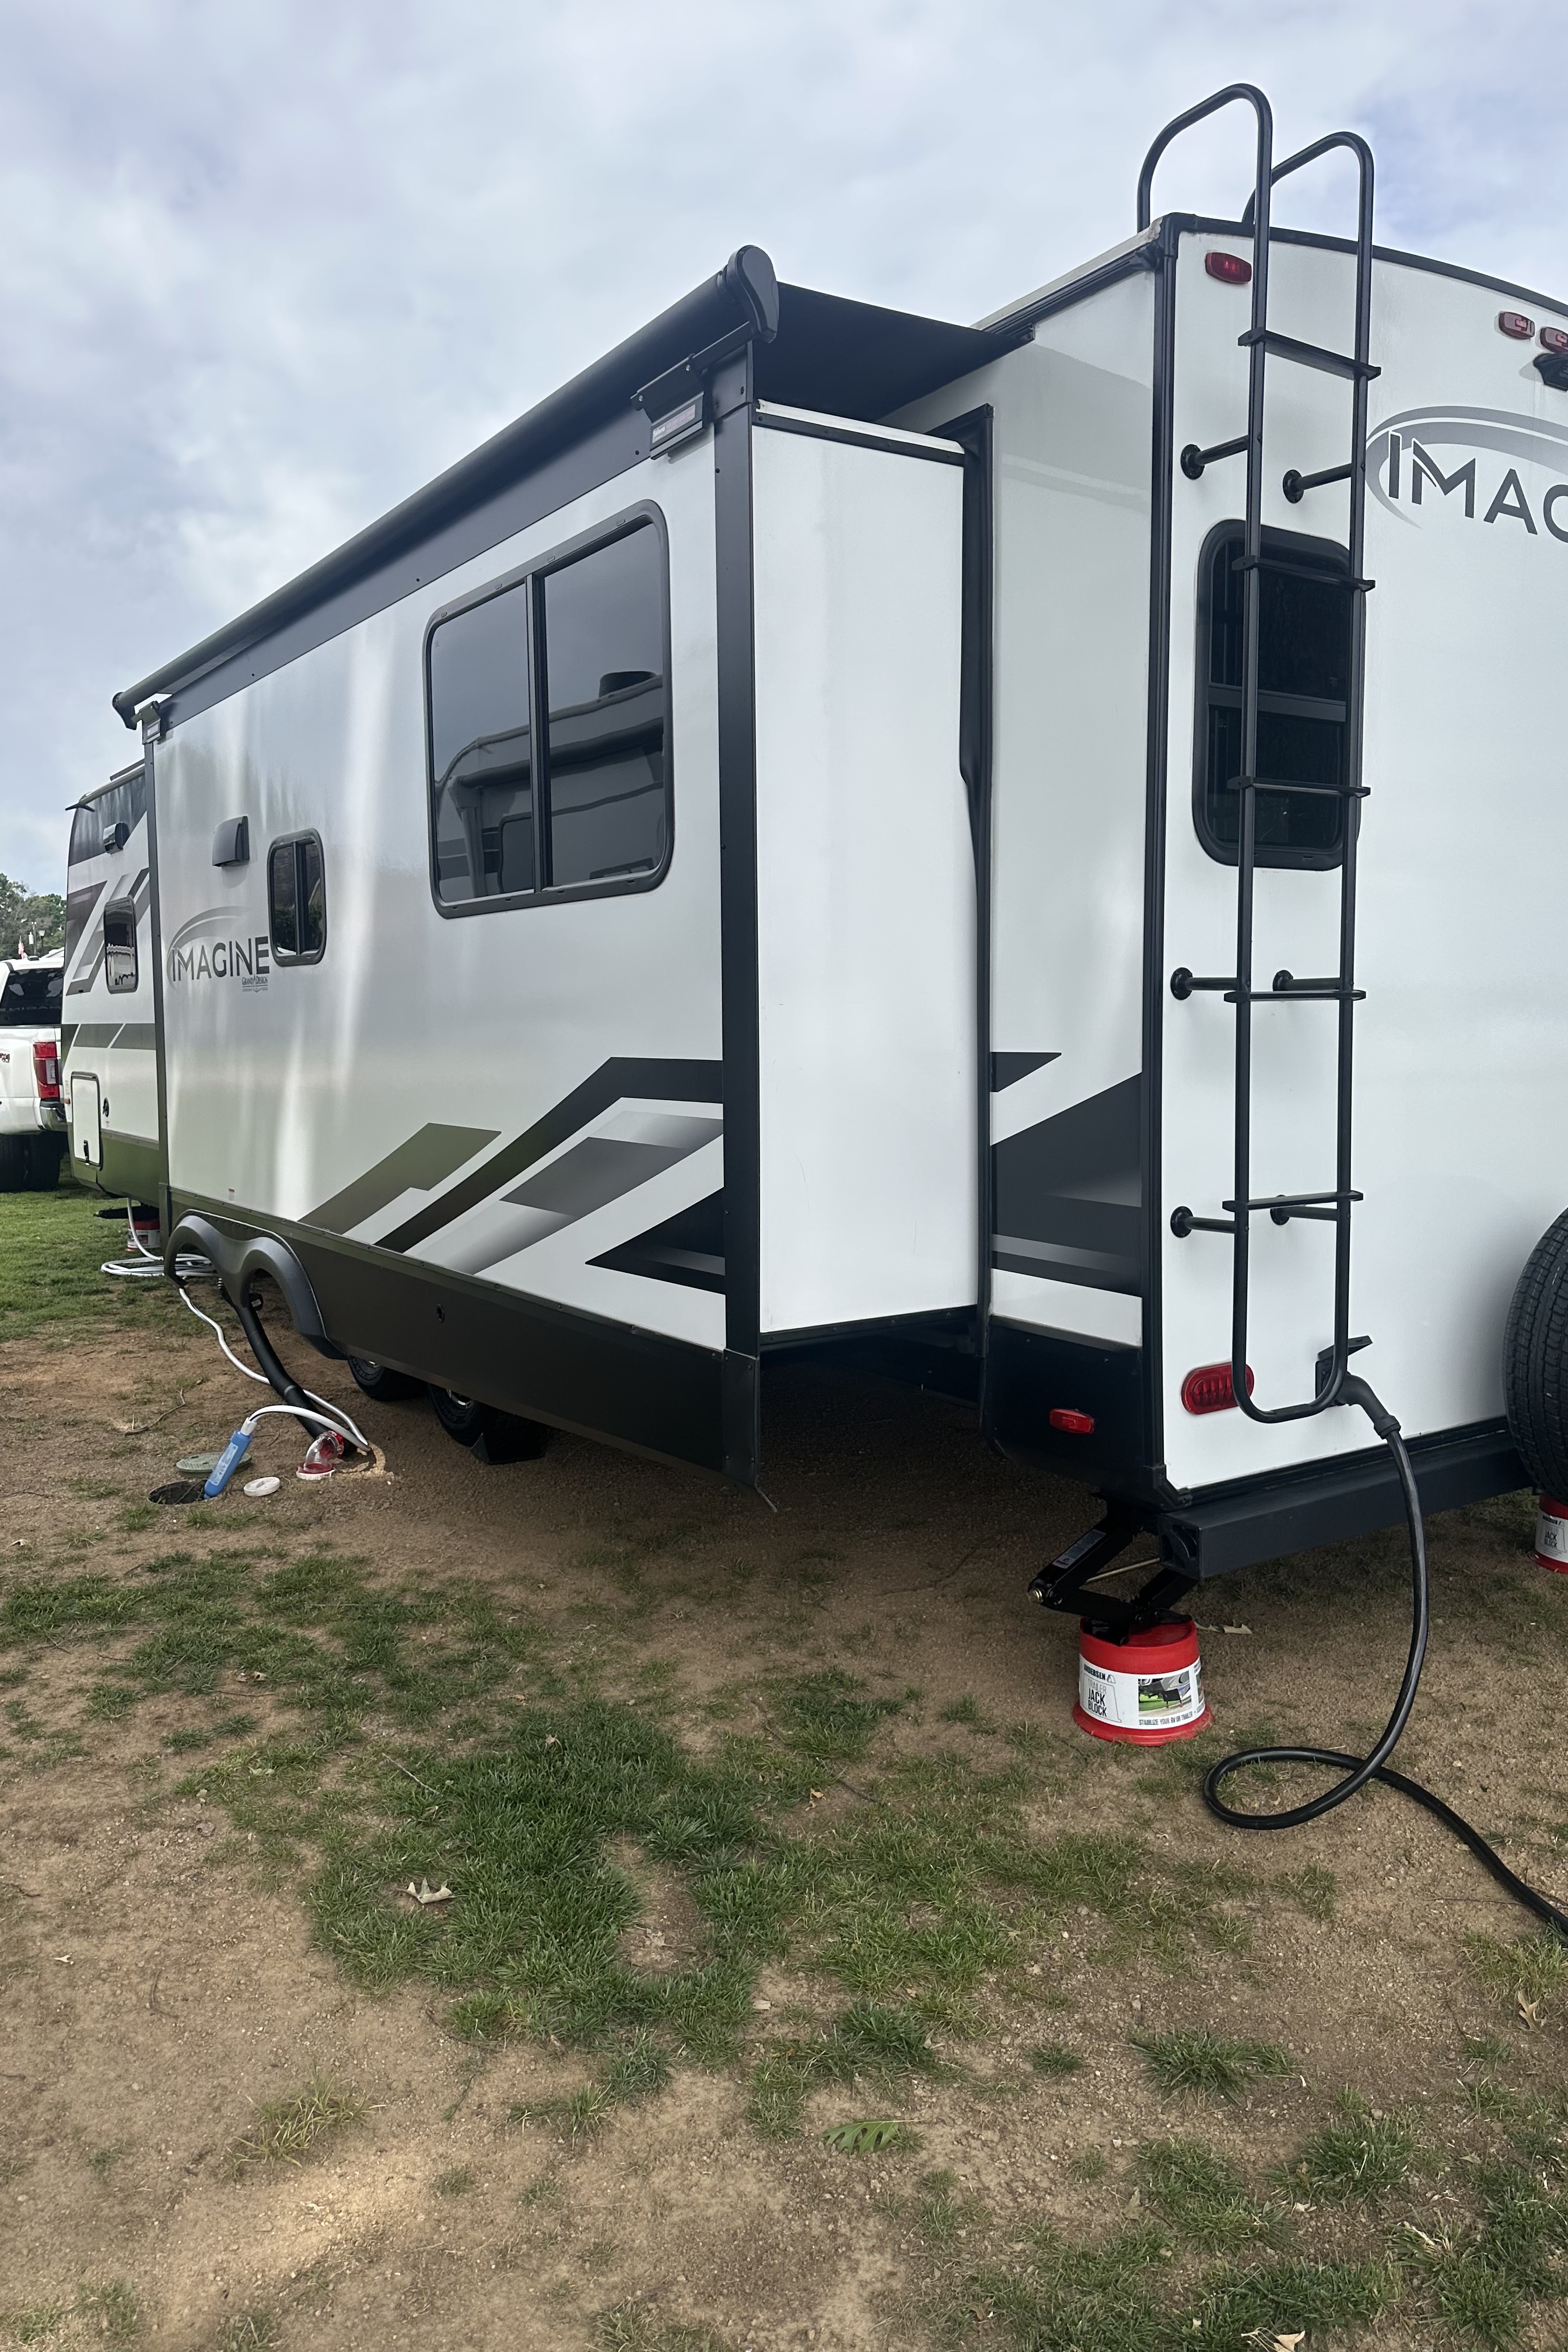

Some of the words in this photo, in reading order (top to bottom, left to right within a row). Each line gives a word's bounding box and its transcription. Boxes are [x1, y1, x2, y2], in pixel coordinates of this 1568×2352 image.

[172, 936, 270, 982] IMAGINE
[1084, 1663, 1106, 1681] ANDERSEN
[1087, 1678, 1107, 1694] TRAILER
[1088, 1688, 1105, 1707] JACK
[1088, 1699, 1107, 1717] BLOCK
